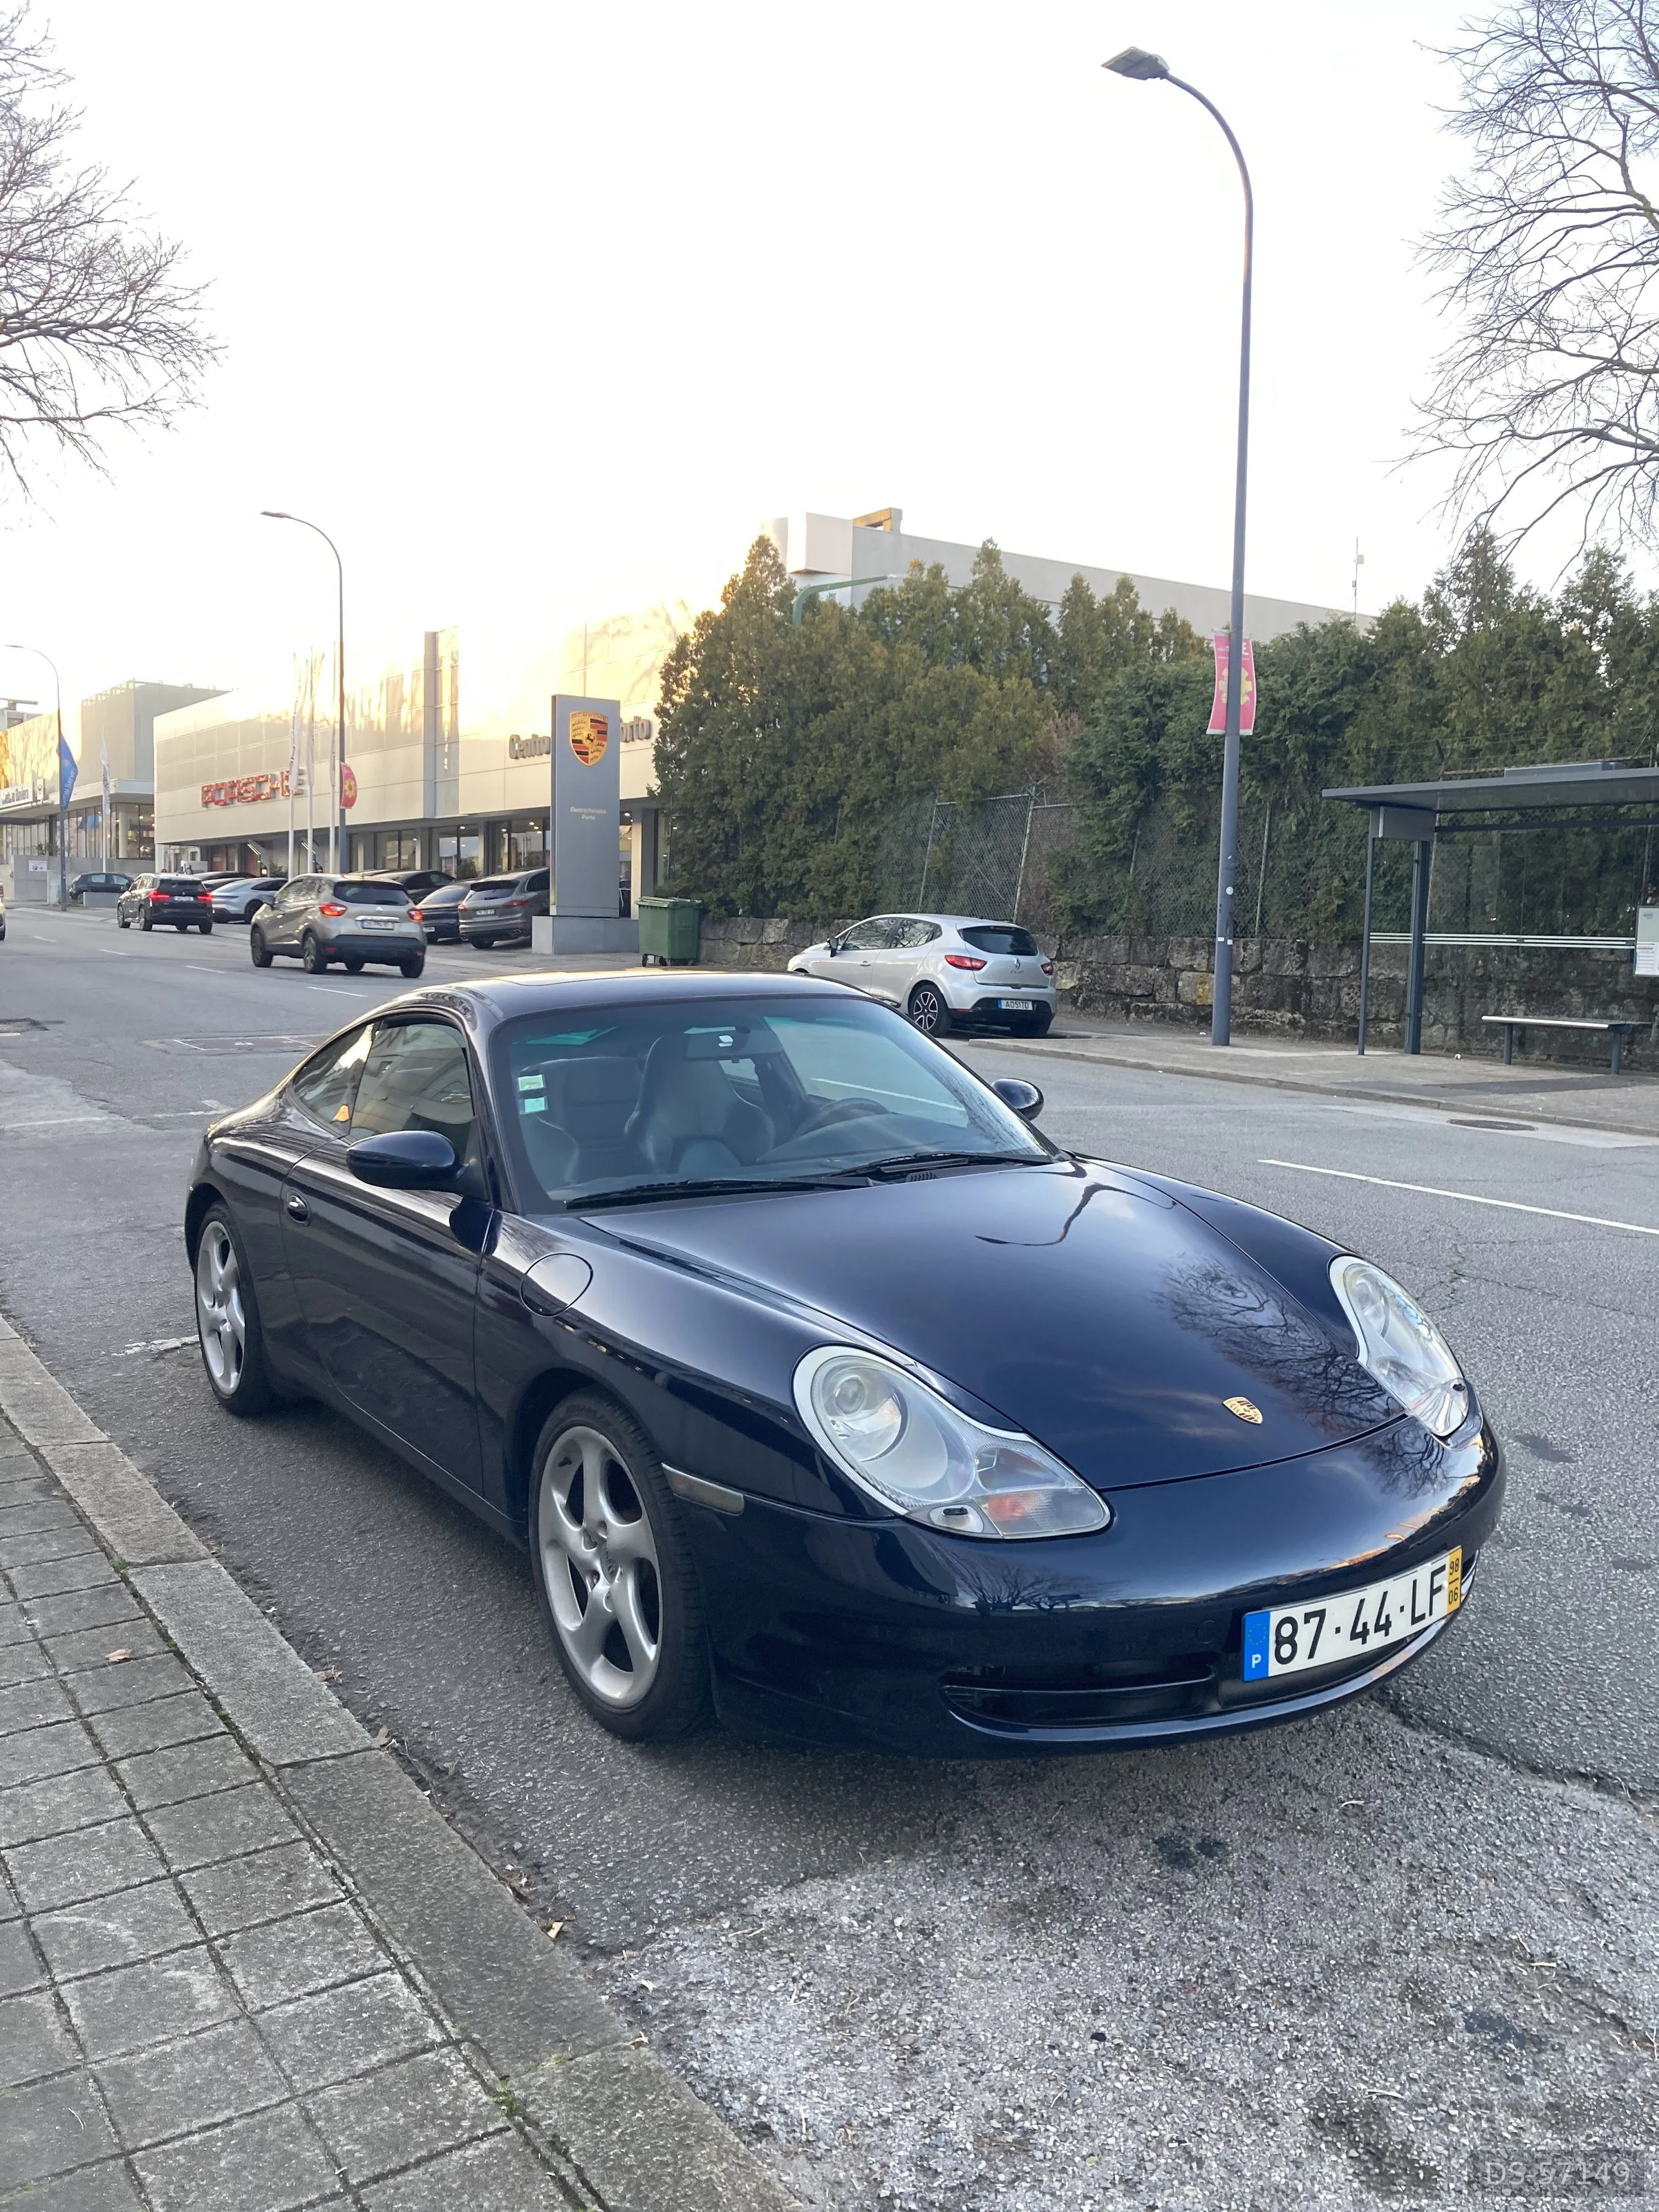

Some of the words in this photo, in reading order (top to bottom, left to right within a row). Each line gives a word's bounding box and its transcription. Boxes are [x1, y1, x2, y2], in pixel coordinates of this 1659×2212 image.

[620, 716, 652, 742] orto
[201, 769, 303, 808] PORSCHE
[1449, 1557, 1460, 1575] 98
[1448, 1593, 1459, 1605] 06
[1251, 1653, 1262, 1669] P
